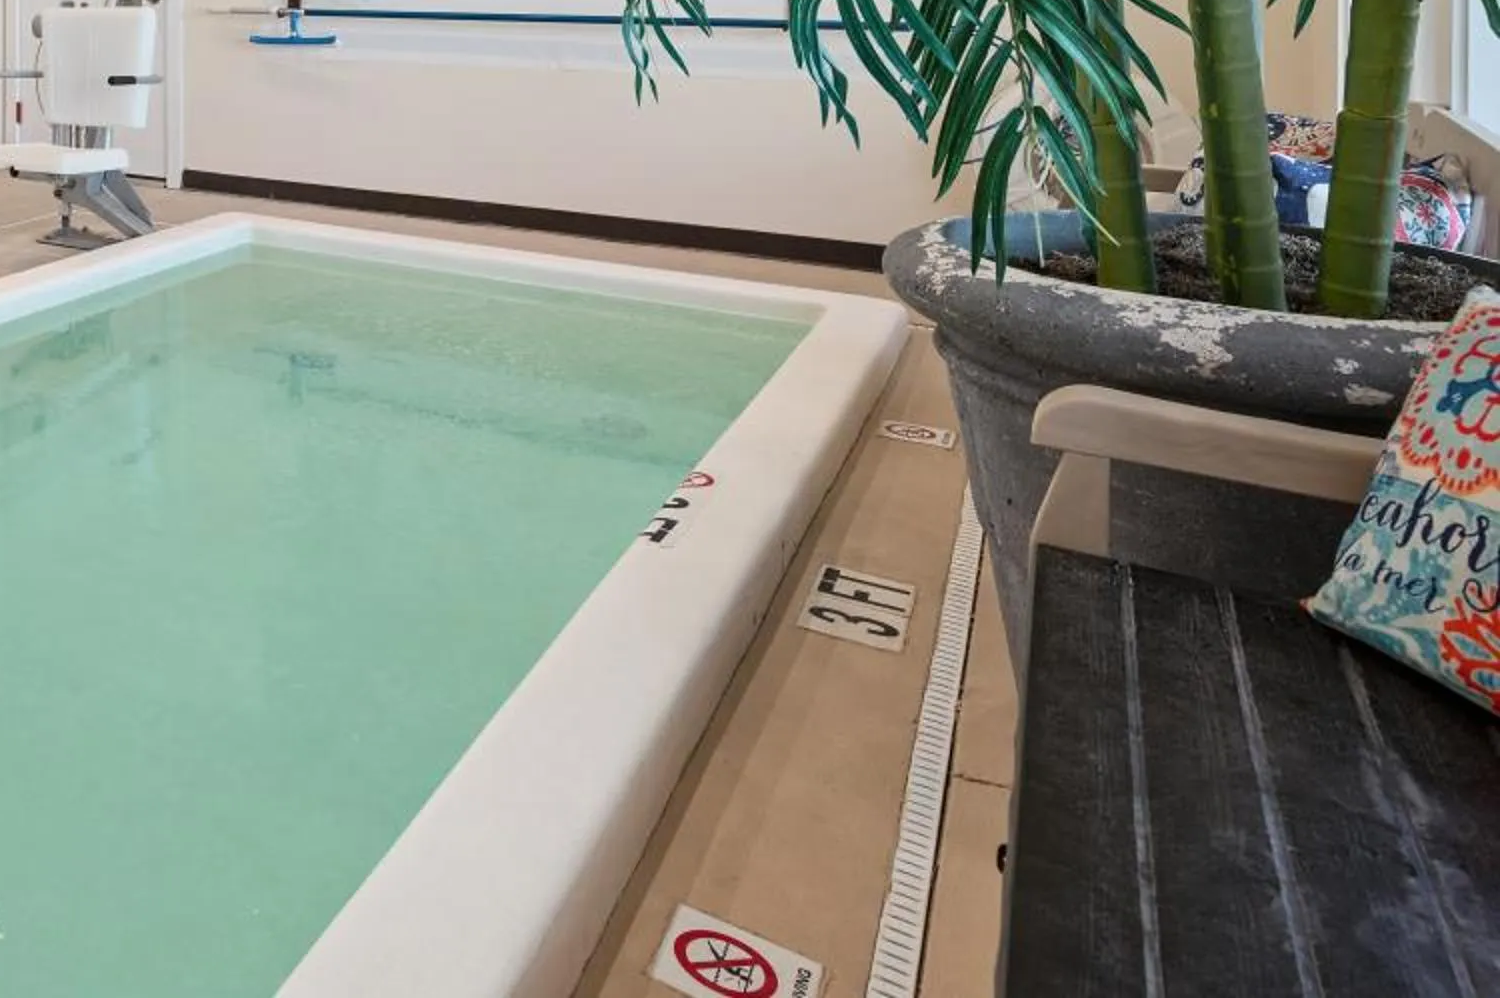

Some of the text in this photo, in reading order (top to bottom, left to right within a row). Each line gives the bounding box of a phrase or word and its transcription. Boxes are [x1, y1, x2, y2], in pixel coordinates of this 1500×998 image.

[1360, 476, 1500, 612] eahor
[808, 567, 911, 637] 3 FT
